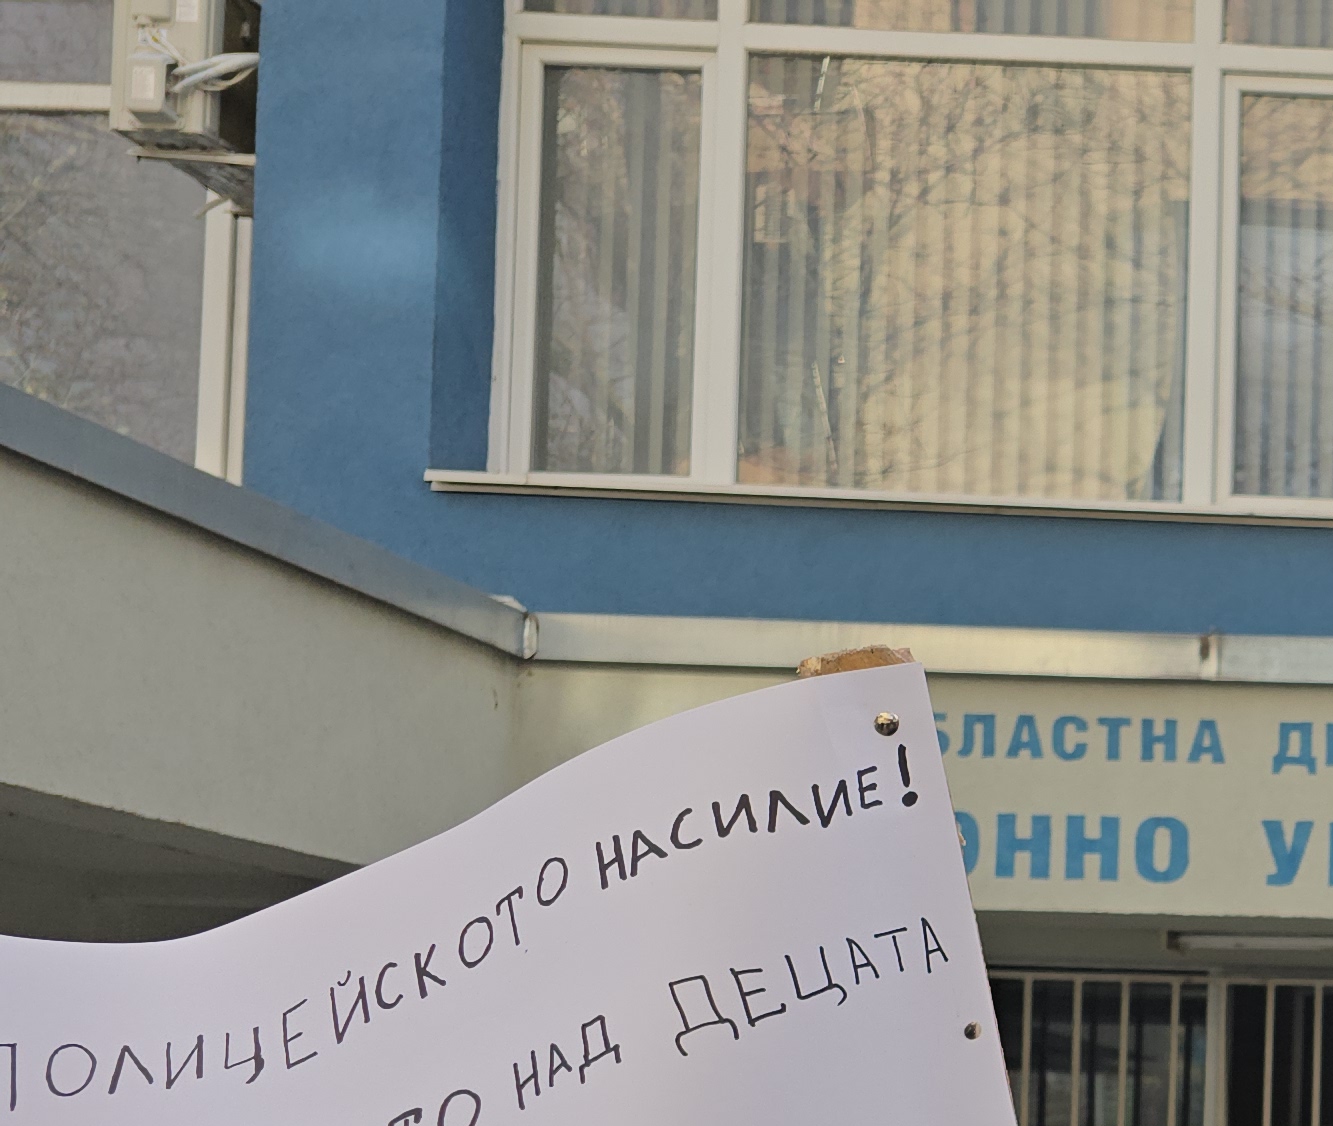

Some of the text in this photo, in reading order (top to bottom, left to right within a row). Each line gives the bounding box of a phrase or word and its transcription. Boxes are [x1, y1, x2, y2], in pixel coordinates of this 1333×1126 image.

[595, 744, 919, 890] НАСИЛИЕ!
[512, 1014, 622, 1110] НАД
[668, 916, 949, 1057] ДЕЦАТА
